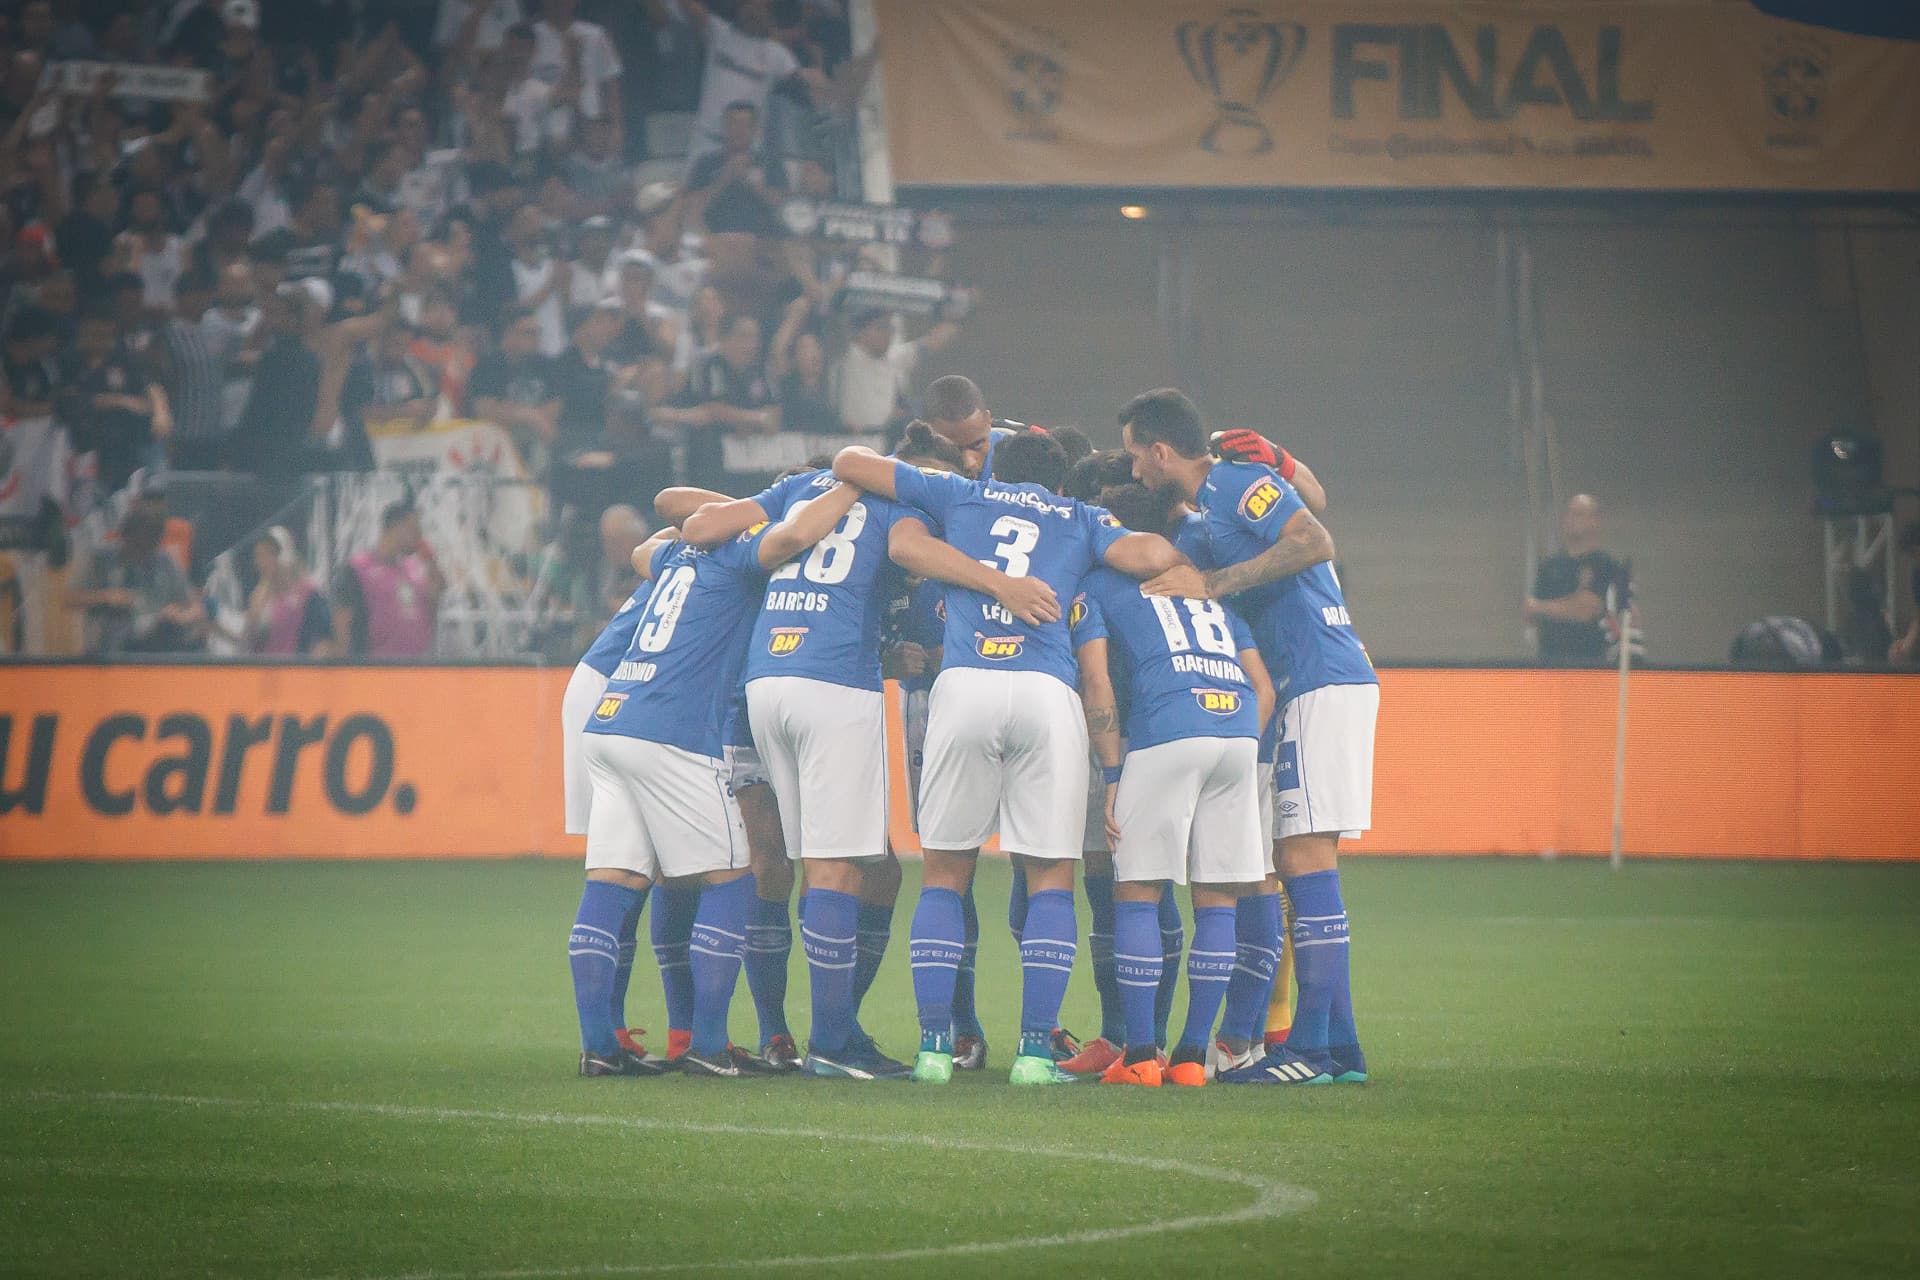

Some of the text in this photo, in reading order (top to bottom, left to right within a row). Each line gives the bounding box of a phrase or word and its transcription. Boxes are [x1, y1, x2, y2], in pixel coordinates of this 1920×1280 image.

[1331, 23, 1654, 121] FINAL
[1247, 483, 1280, 518] BH
[979, 515, 1040, 578] 3
[766, 591, 829, 612] BARCOS
[1140, 590, 1236, 658] 18
[1171, 654, 1246, 684] RAFINHA
[1204, 693, 1235, 710] BH
[80, 710, 420, 819] carro.
